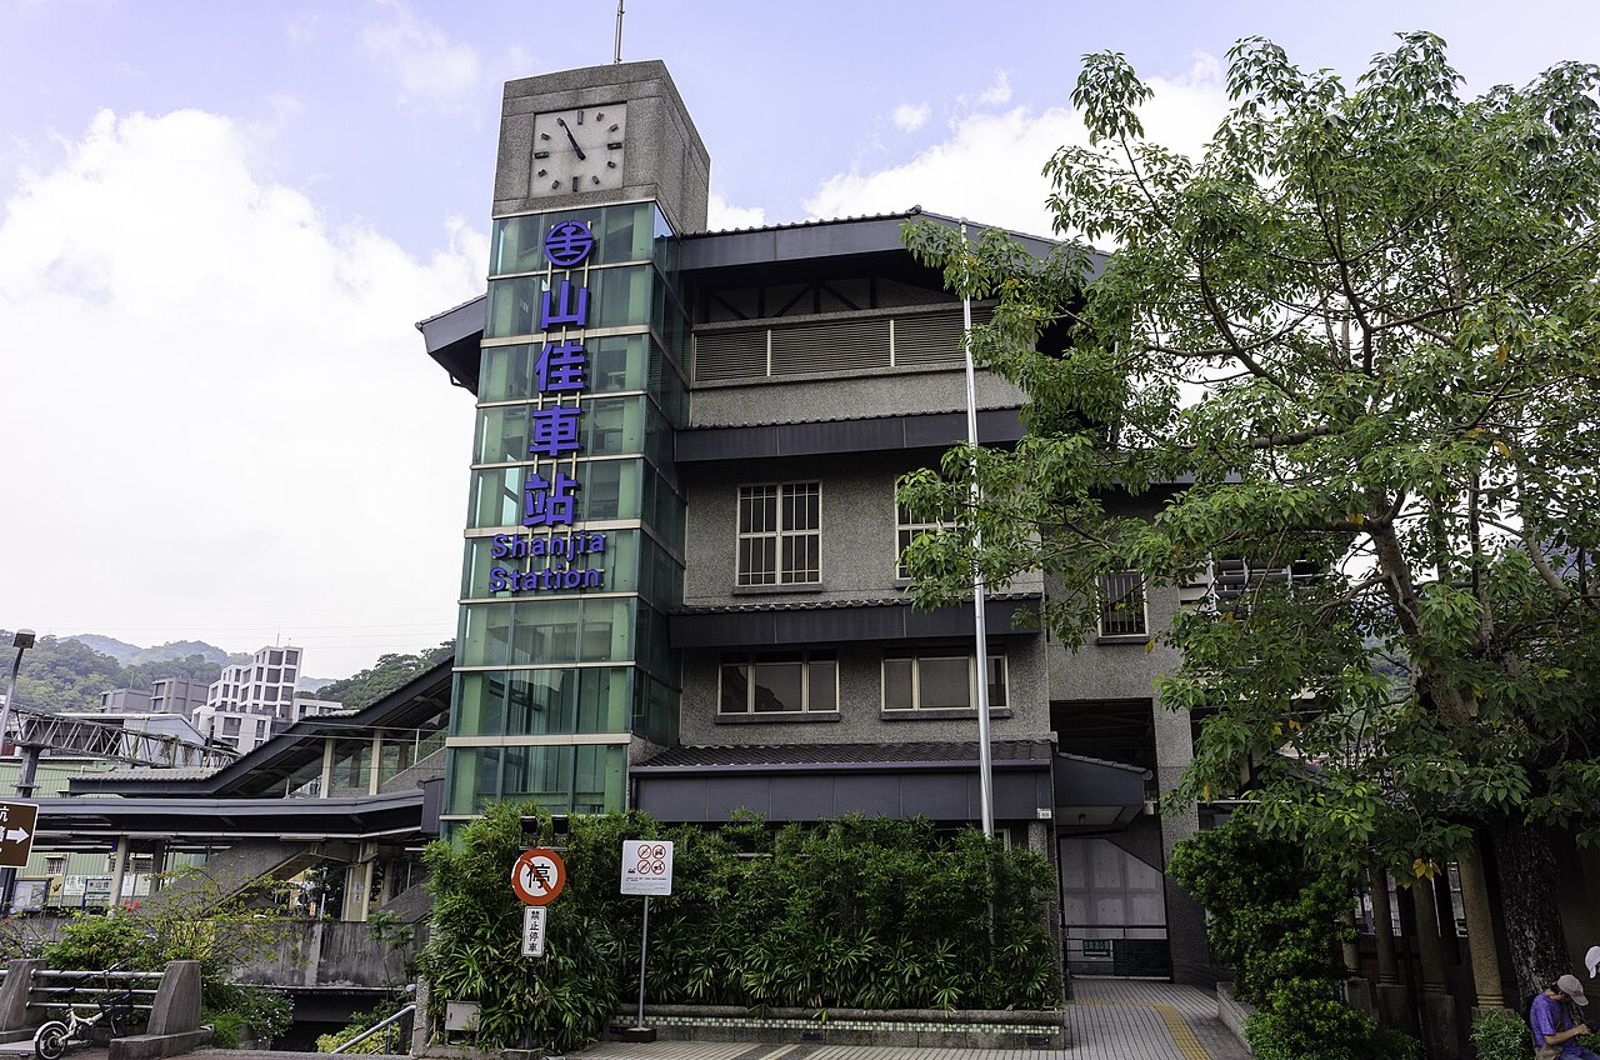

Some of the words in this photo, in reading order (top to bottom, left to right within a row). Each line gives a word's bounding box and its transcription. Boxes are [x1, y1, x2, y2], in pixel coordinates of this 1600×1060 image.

[522, 280, 588, 527] 山佳車站
[491, 530, 606, 562] Shanjia
[489, 564, 600, 592] Station
[526, 863, 550, 889] 停
[528, 910, 540, 952] 禁止停車
